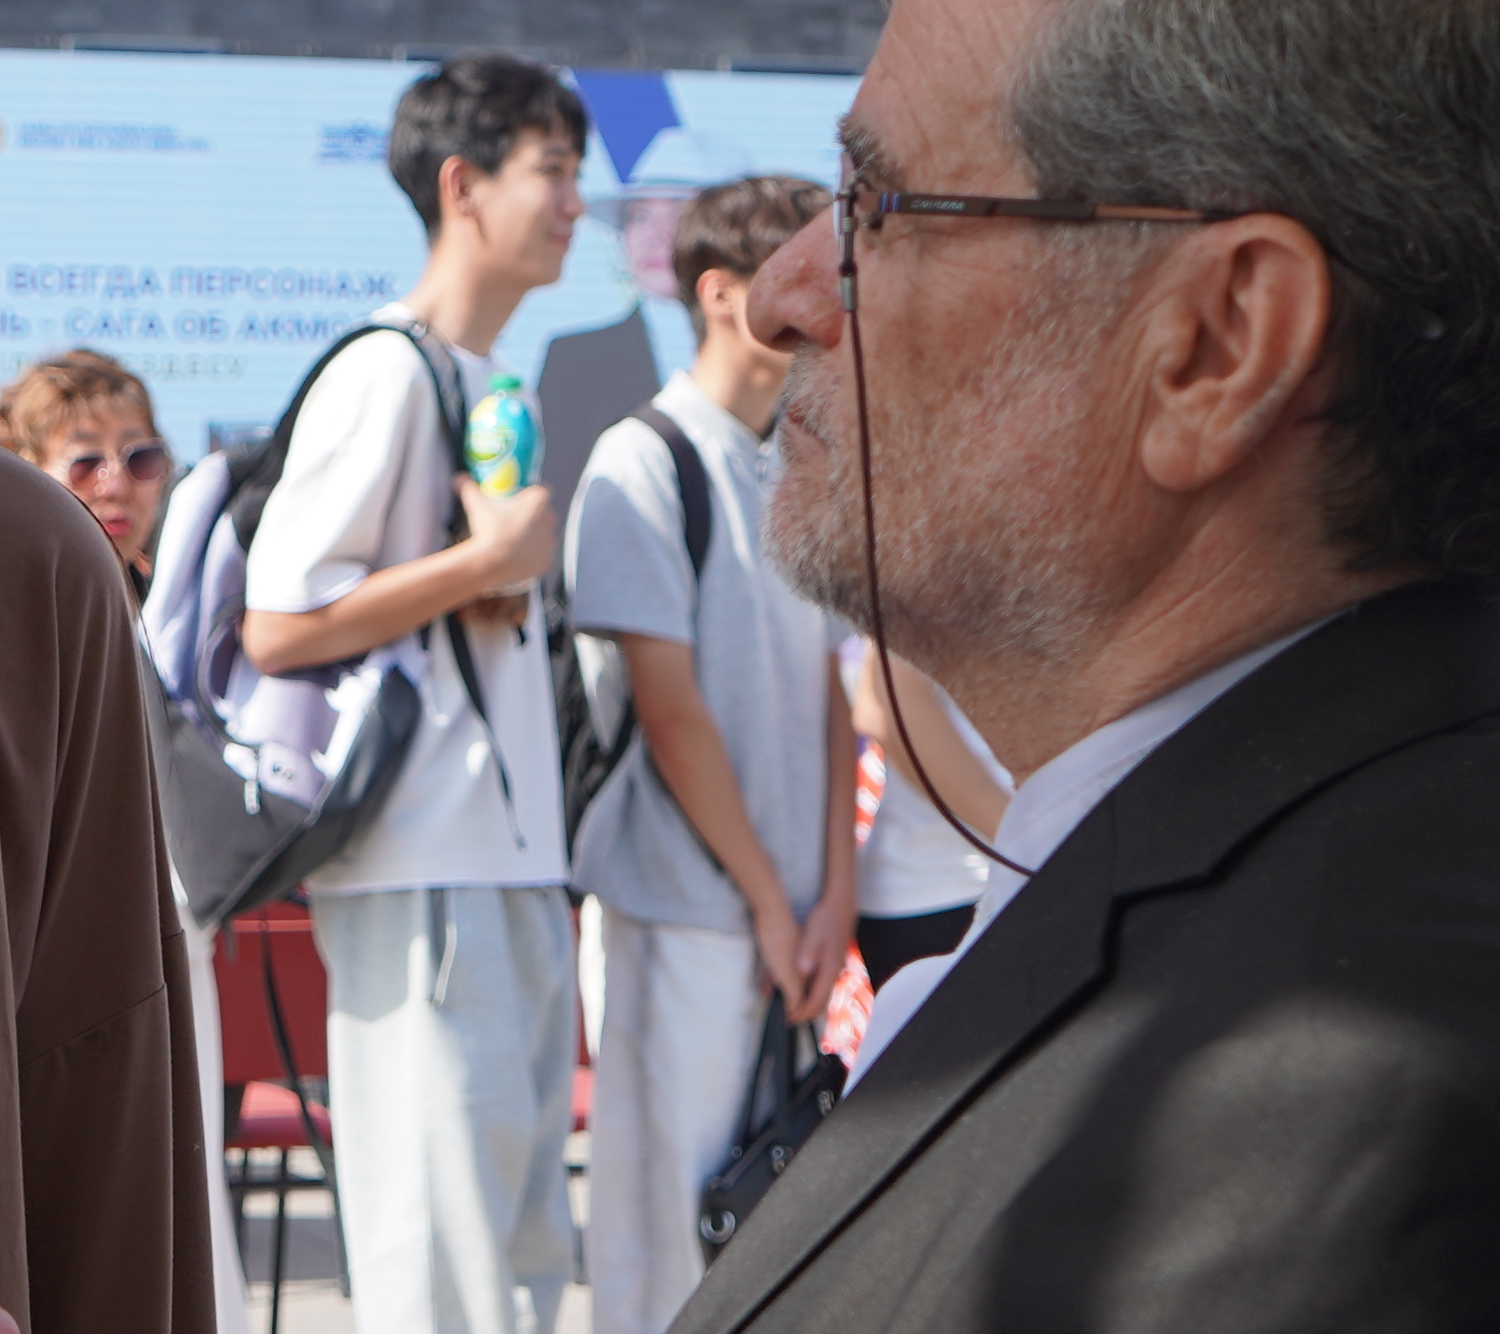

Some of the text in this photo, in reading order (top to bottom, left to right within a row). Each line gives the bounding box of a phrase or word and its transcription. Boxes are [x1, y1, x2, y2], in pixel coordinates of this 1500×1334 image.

[6, 262, 163, 300] ВСЕГДА
[169, 265, 400, 302] ПЕРСОНАЖ
[63, 307, 168, 343] САГА
[173, 308, 231, 344] ОБ
